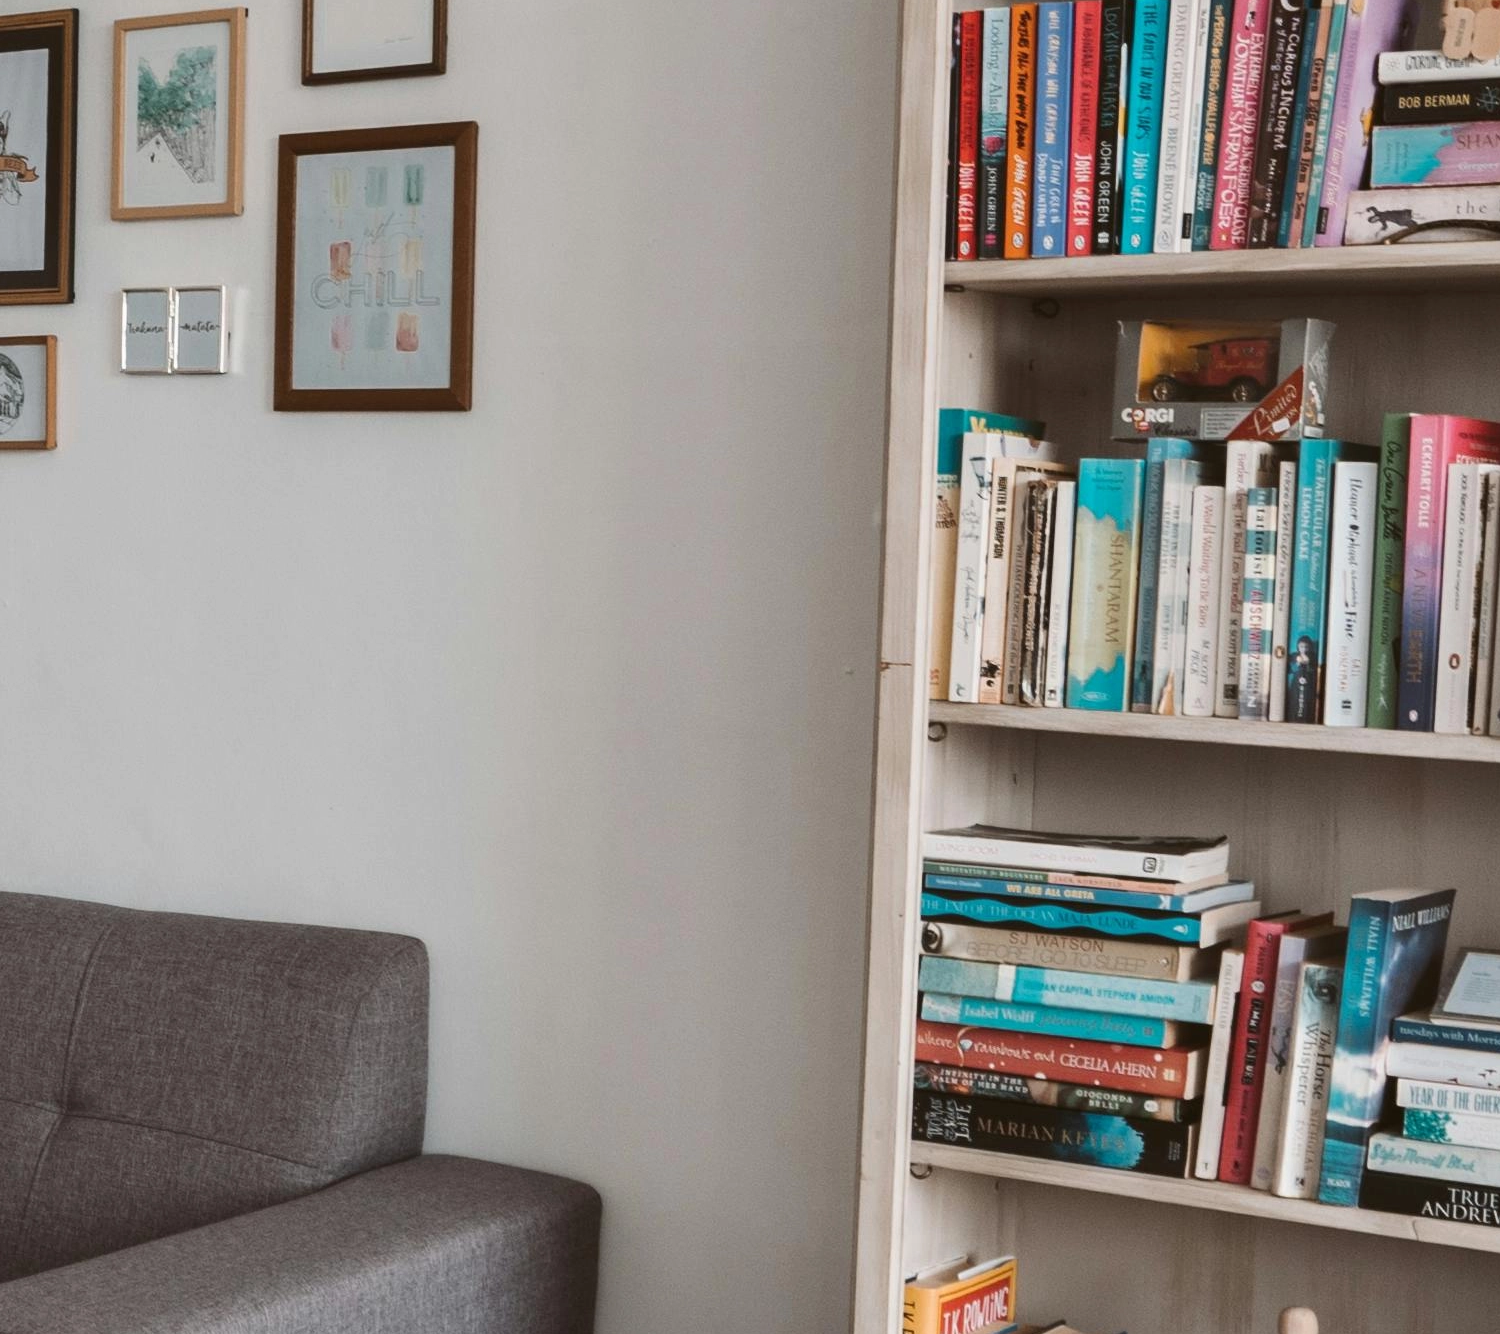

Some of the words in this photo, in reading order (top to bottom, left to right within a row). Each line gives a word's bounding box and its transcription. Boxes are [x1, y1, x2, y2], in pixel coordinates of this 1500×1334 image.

[1143, 4, 1157, 25] THE
[1173, 4, 1188, 58] DARING
[985, 19, 1003, 70] Looking
[1140, 67, 1153, 77] IN
[1231, 32, 1250, 107] JONATHAN
[1246, 33, 1264, 97] EXTREMELY
[1168, 61, 1184, 121] GREATLY
[1398, 96, 1421, 109] BOB
[1425, 93, 1470, 107] BERMAN
[1136, 107, 1151, 140] STARS
[1242, 101, 1257, 134] LOUD
[1099, 140, 1112, 175] JOHN
[1165, 127, 1180, 172] BRENÉ
[1226, 111, 1243, 172] SAFRAN
[1242, 136, 1252, 145] &
[958, 161, 973, 190] JOHN
[987, 166, 998, 194] JOHN
[1013, 154, 1027, 184] JOHN
[1073, 153, 1092, 183] JOHN
[1130, 151, 1149, 180] JOHN
[1236, 147, 1254, 207] INCREDIBLY
[958, 193, 973, 232] GREEN
[986, 197, 997, 231] GREEN
[1012, 187, 1025, 226] GREEN
[1073, 187, 1090, 226] GREEN
[1098, 181, 1110, 223] GREEN
[1130, 185, 1146, 223] GREEN
[1161, 175, 1176, 225] BROWN
[1218, 175, 1237, 229] FOER
[1231, 209, 1248, 244] CLOSE
[310, 269, 441, 310] CHILL
[1121, 408, 1174, 423] CORGI
[1419, 437, 1433, 491] ECKHART
[1417, 494, 1431, 528] TOLLE
[1105, 534, 1124, 643] SHANTARAM
[1009, 932, 1032, 945] SJ
[1035, 933, 1105, 953] WATSON
[1366, 916, 1380, 953] NIALL
[1358, 957, 1376, 1017] WILLIAMS
[1400, 1025, 1439, 1039] tuesdays
[1441, 1029, 1464, 1041] with
[1034, 1049, 1055, 1063] end
[1060, 1054, 1110, 1073] CECELIA
[1112, 1061, 1157, 1079] AHERN
[1409, 1085, 1434, 1105] YEAR
[1437, 1088, 1449, 1106] OF
[1453, 1089, 1470, 1108] THE
[977, 1116, 1054, 1141] MARIAN
[1448, 1187, 1498, 1210] TRUE
[963, 1286, 1009, 1331] ROWLING
